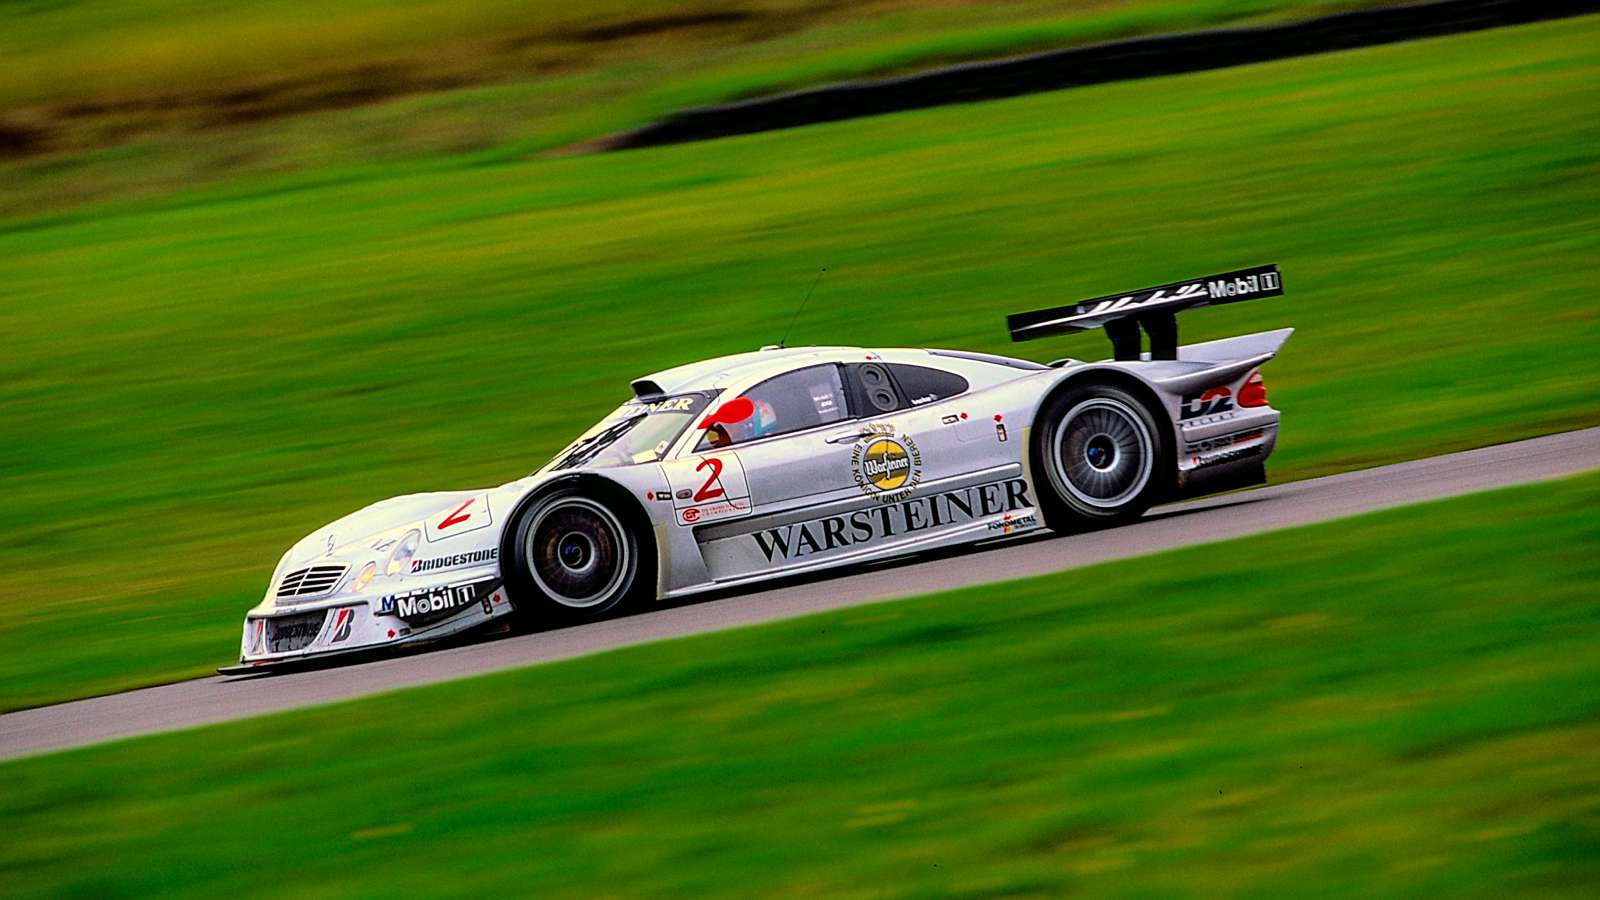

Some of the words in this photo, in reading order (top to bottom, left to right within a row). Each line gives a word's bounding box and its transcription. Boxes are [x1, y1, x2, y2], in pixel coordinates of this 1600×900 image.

[1208, 274, 1258, 299] Mobil
[1180, 386, 1233, 420] D2
[851, 443, 863, 466] EINE
[693, 458, 724, 502] 2
[752, 477, 1033, 563] WARSTEINER
[411, 548, 498, 574] BRIDGESTONE
[397, 587, 455, 618] Mobil
